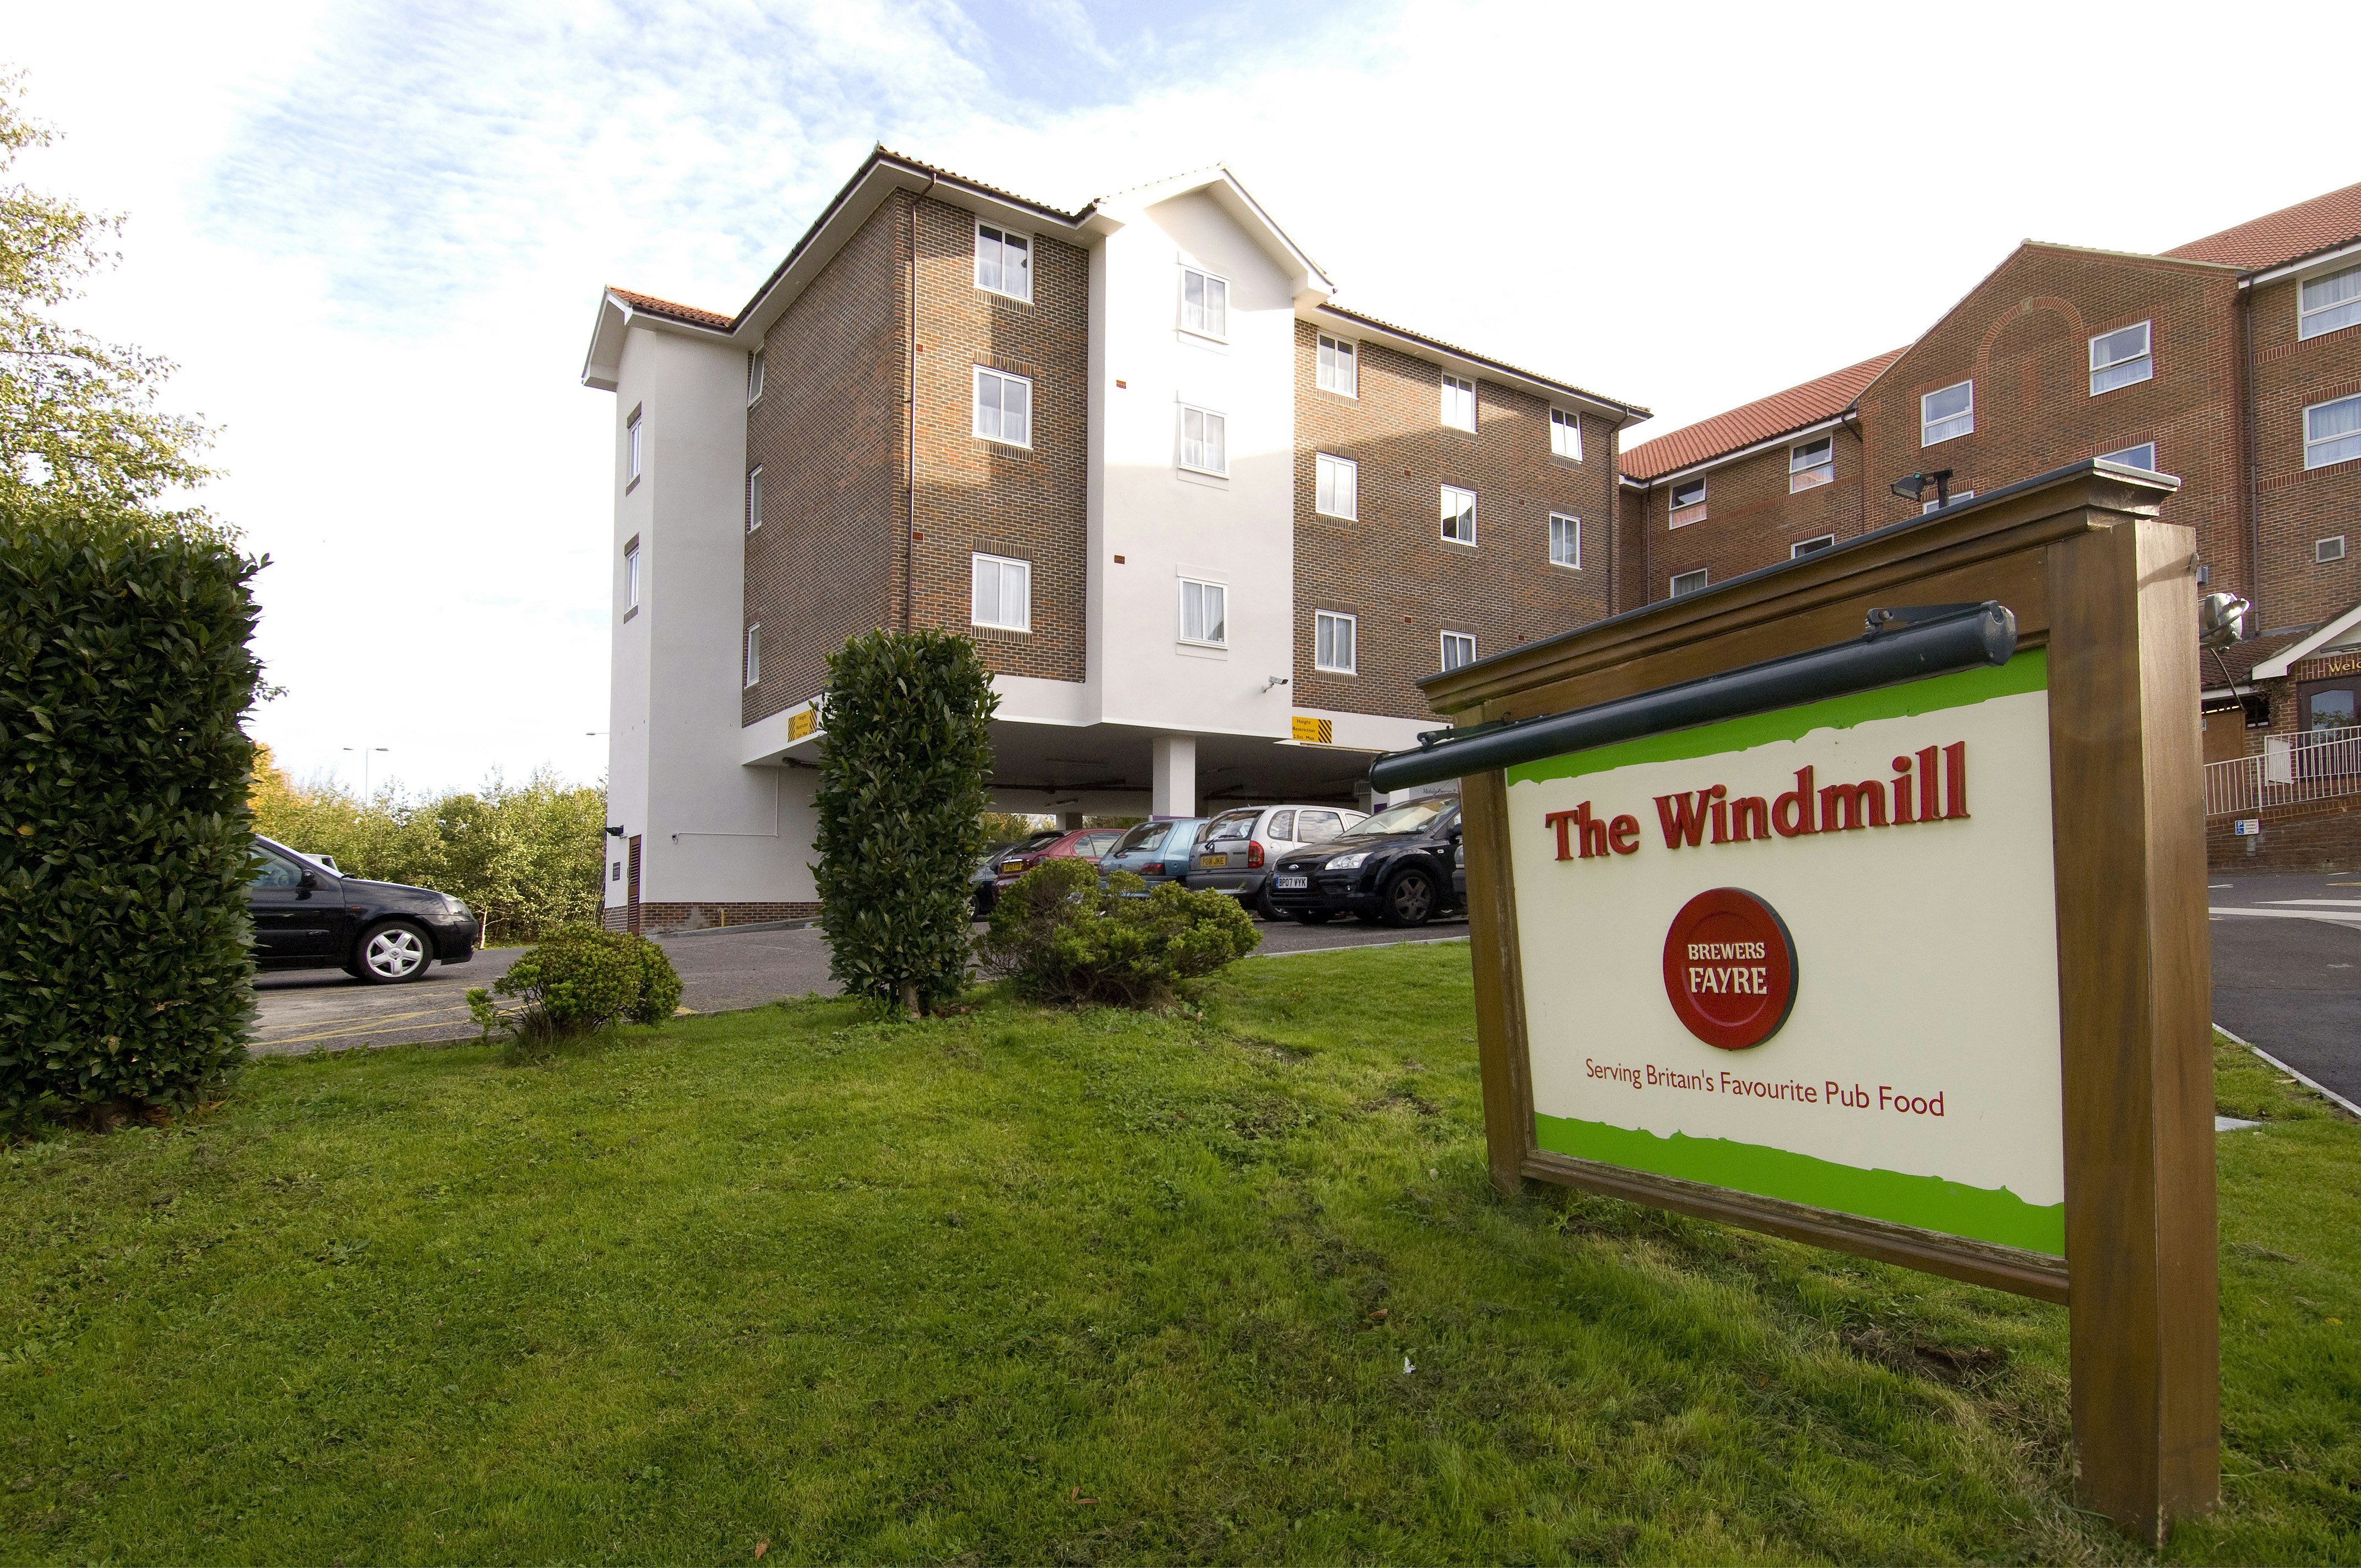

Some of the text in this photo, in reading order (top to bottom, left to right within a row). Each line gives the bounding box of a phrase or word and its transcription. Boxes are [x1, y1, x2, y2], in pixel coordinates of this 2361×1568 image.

[1545, 741, 1971, 861] The Windmill
[1279, 878, 1305, 886] BP07 VYK
[1688, 943, 1765, 960] BREWERS
[1689, 968, 1767, 994] FAYRE
[1586, 1058, 1944, 1117] Serving Britain's Favourite Pub Food
